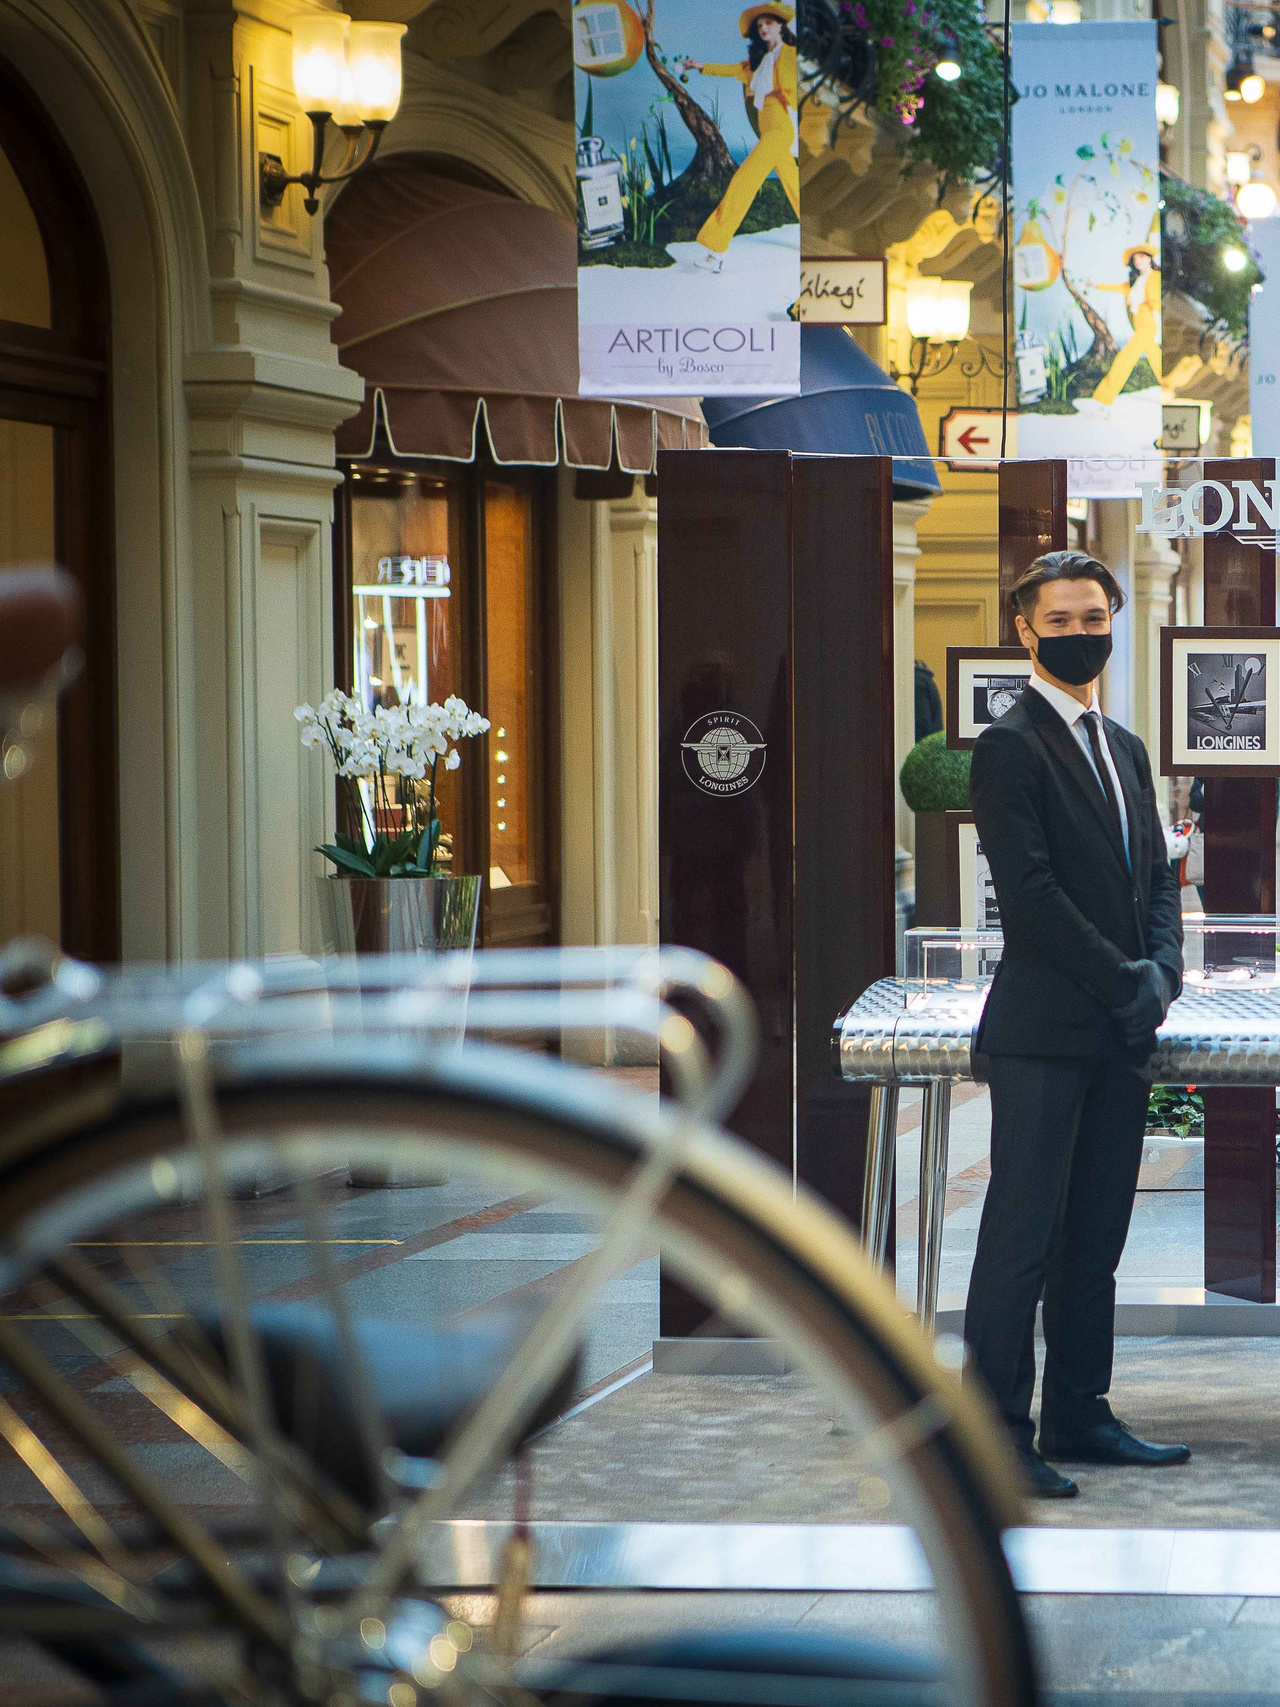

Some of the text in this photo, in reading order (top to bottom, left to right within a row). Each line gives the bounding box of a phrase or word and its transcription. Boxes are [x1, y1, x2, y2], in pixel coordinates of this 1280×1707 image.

[1022, 82, 1150, 99] JO MALONE
[800, 271, 865, 309] iliegi
[608, 327, 775, 354] ARTICOLI
[658, 356, 725, 377] by Bosco
[708, 716, 741, 726] SPIRIT
[1196, 735, 1261, 750] LONGINES
[699, 776, 749, 791] LONGINES
